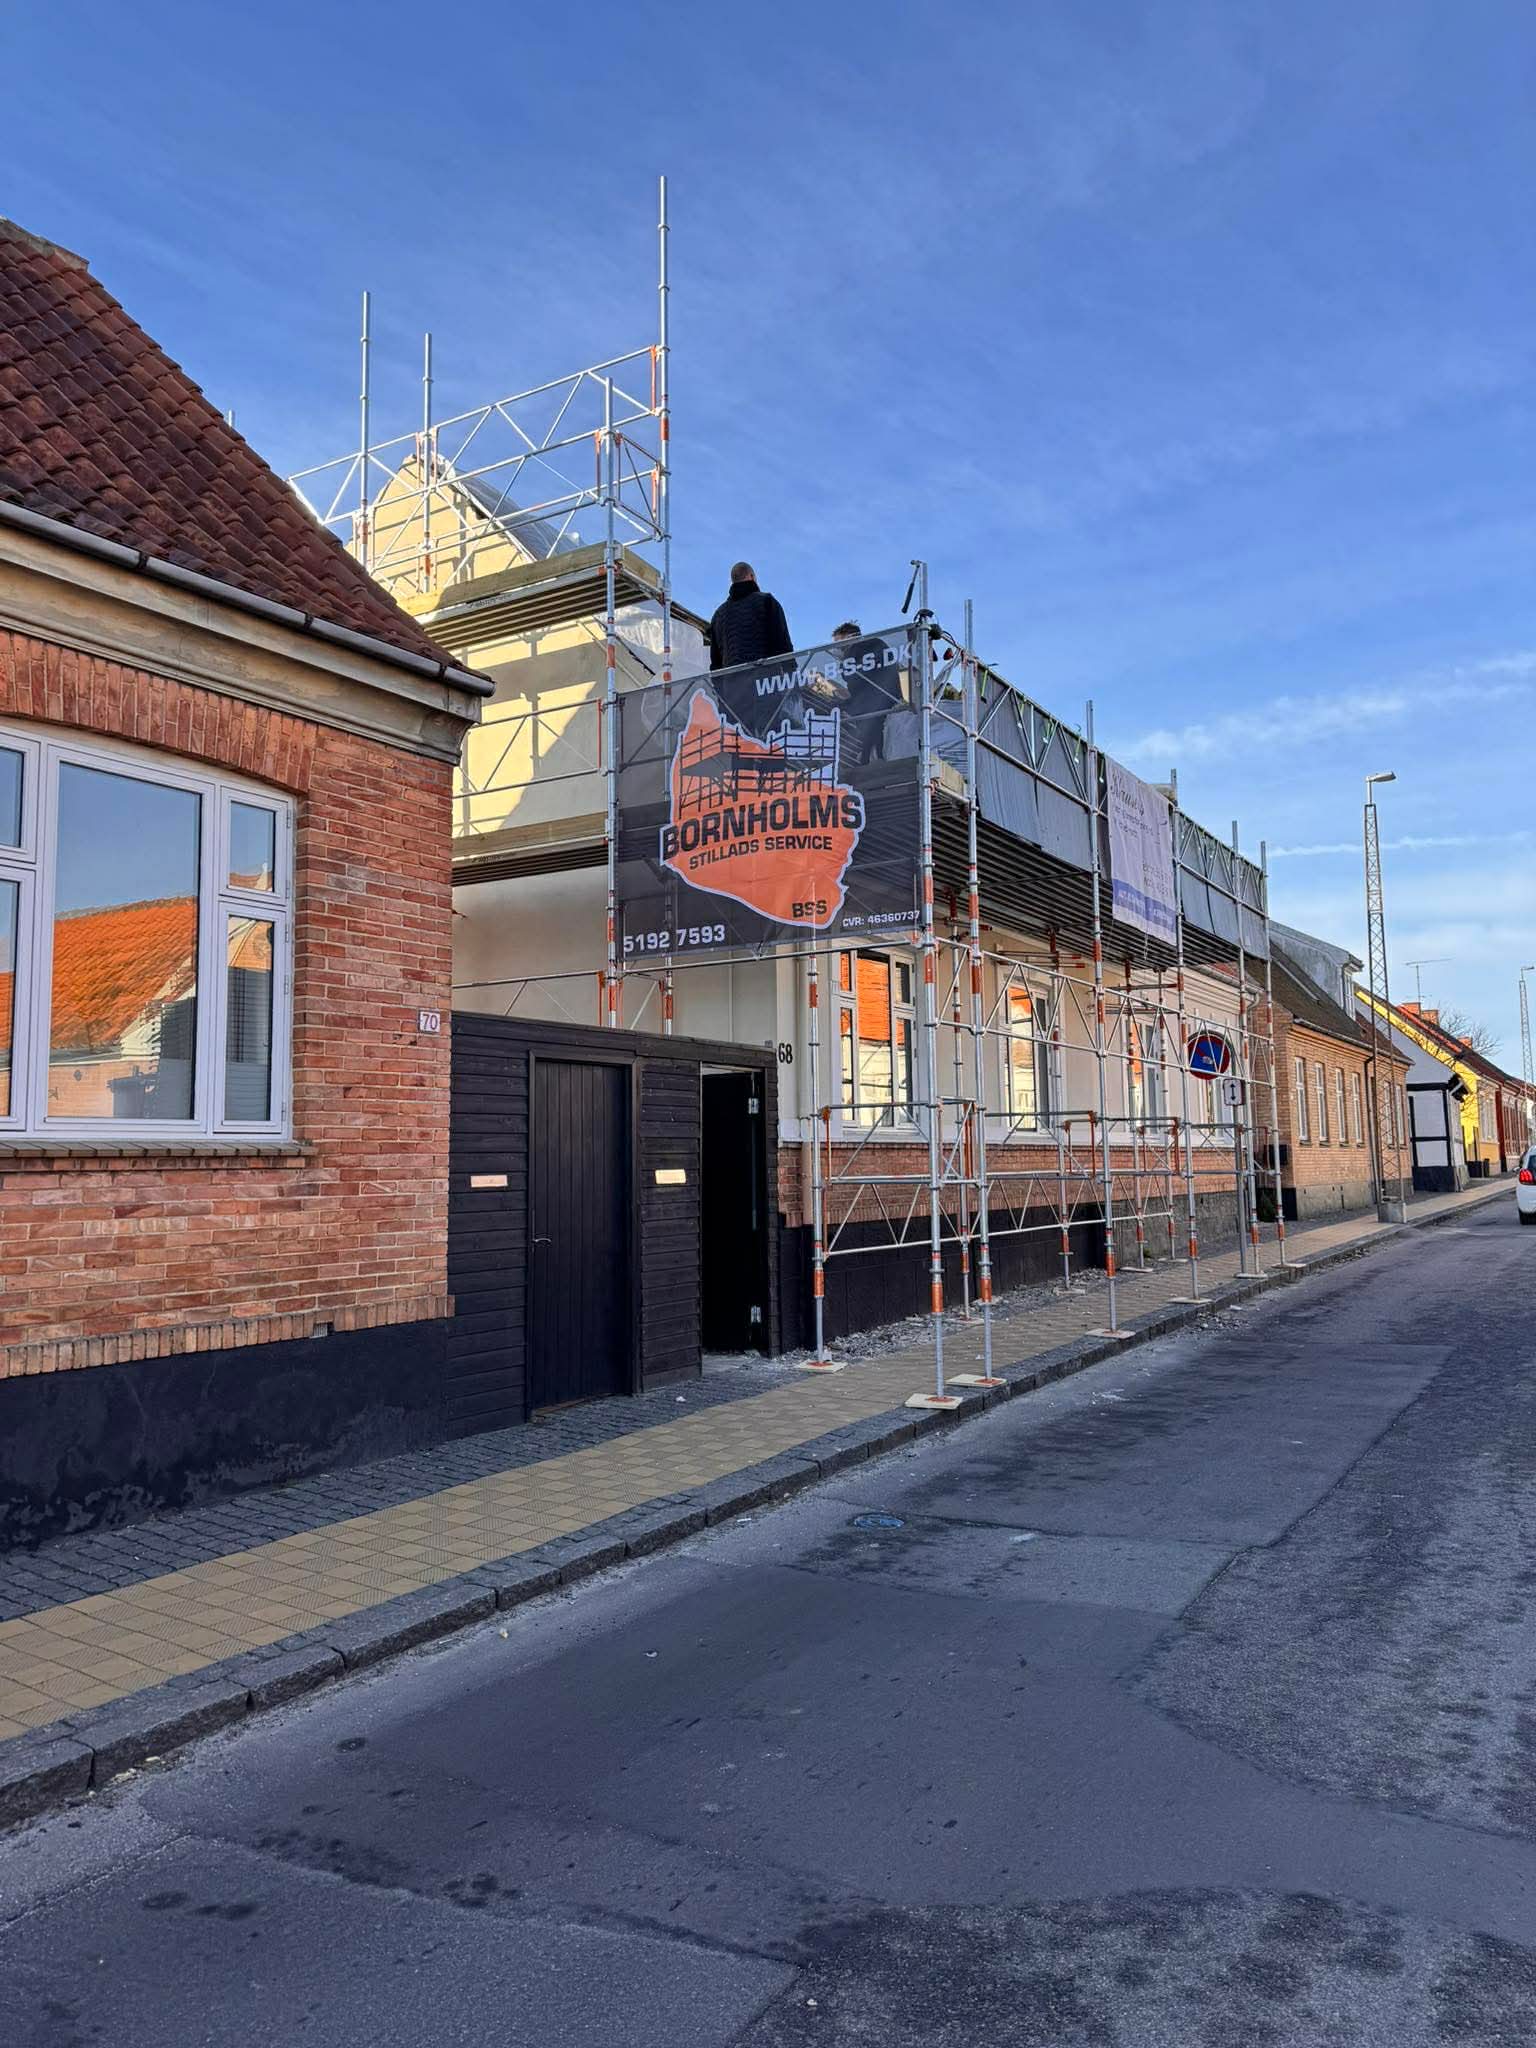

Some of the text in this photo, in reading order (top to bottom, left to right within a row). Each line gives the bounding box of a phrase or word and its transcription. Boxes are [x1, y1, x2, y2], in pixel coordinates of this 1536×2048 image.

[662, 794, 862, 862] BORNHOLMS
[689, 835, 833, 870] STILLADS SERVICE
[792, 900, 828, 918] BSS
[842, 916, 865, 927] CVR:
[624, 924, 726, 952] 5192 7593
[423, 1013, 438, 1030] 70
[778, 1042, 793, 1065] 68
